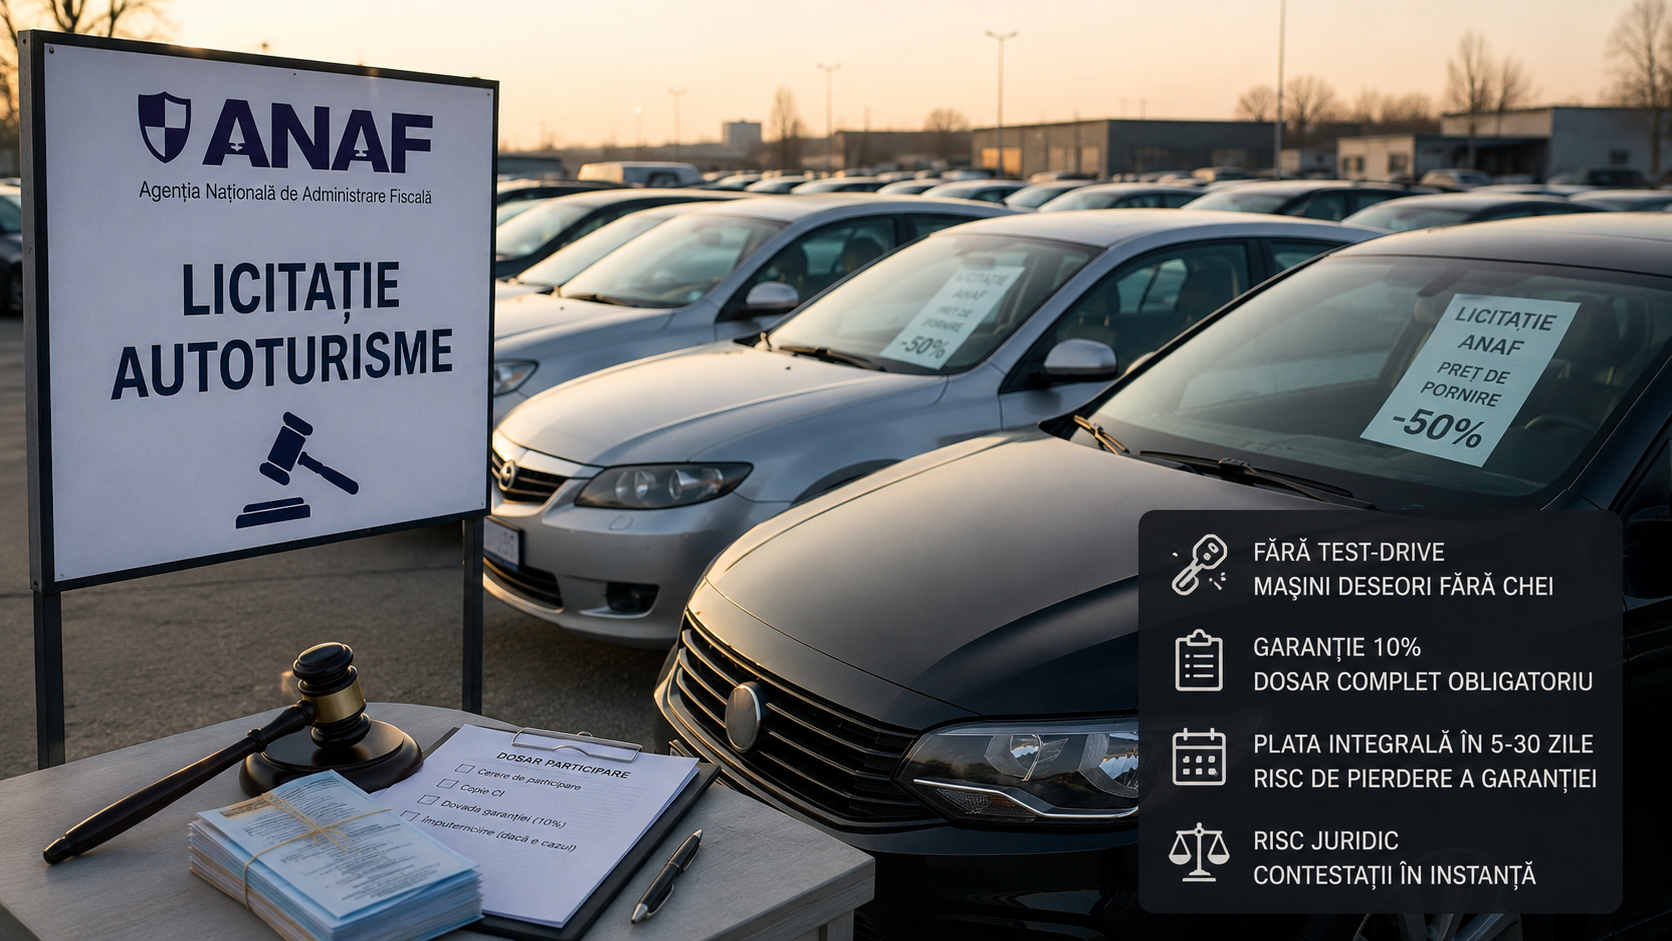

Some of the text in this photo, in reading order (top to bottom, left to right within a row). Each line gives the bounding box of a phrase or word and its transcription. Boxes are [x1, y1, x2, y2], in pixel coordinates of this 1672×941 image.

[202, 98, 433, 173] ANAF
[139, 180, 432, 204] Agenția Națională de Administrare Fiscală
[183, 261, 399, 324] LICITAȚIE
[1455, 306, 1557, 332] LICITAȚIE
[901, 335, 950, 359] -50%
[1457, 334, 1525, 356] ANAF
[111, 328, 453, 400] AUTOTURISME
[1437, 361, 1511, 385] PREȚ DE
[1420, 381, 1502, 408] PORNIRE
[1392, 408, 1485, 449] -50%
[477, 768, 511, 779] Cerere
[511, 774, 525, 782] de
[496, 751, 631, 779] DOSAR PARTICIPARE
[440, 799, 482, 814] Dovada
[532, 816, 567, 830] (10%)
[530, 838, 540, 846] e
